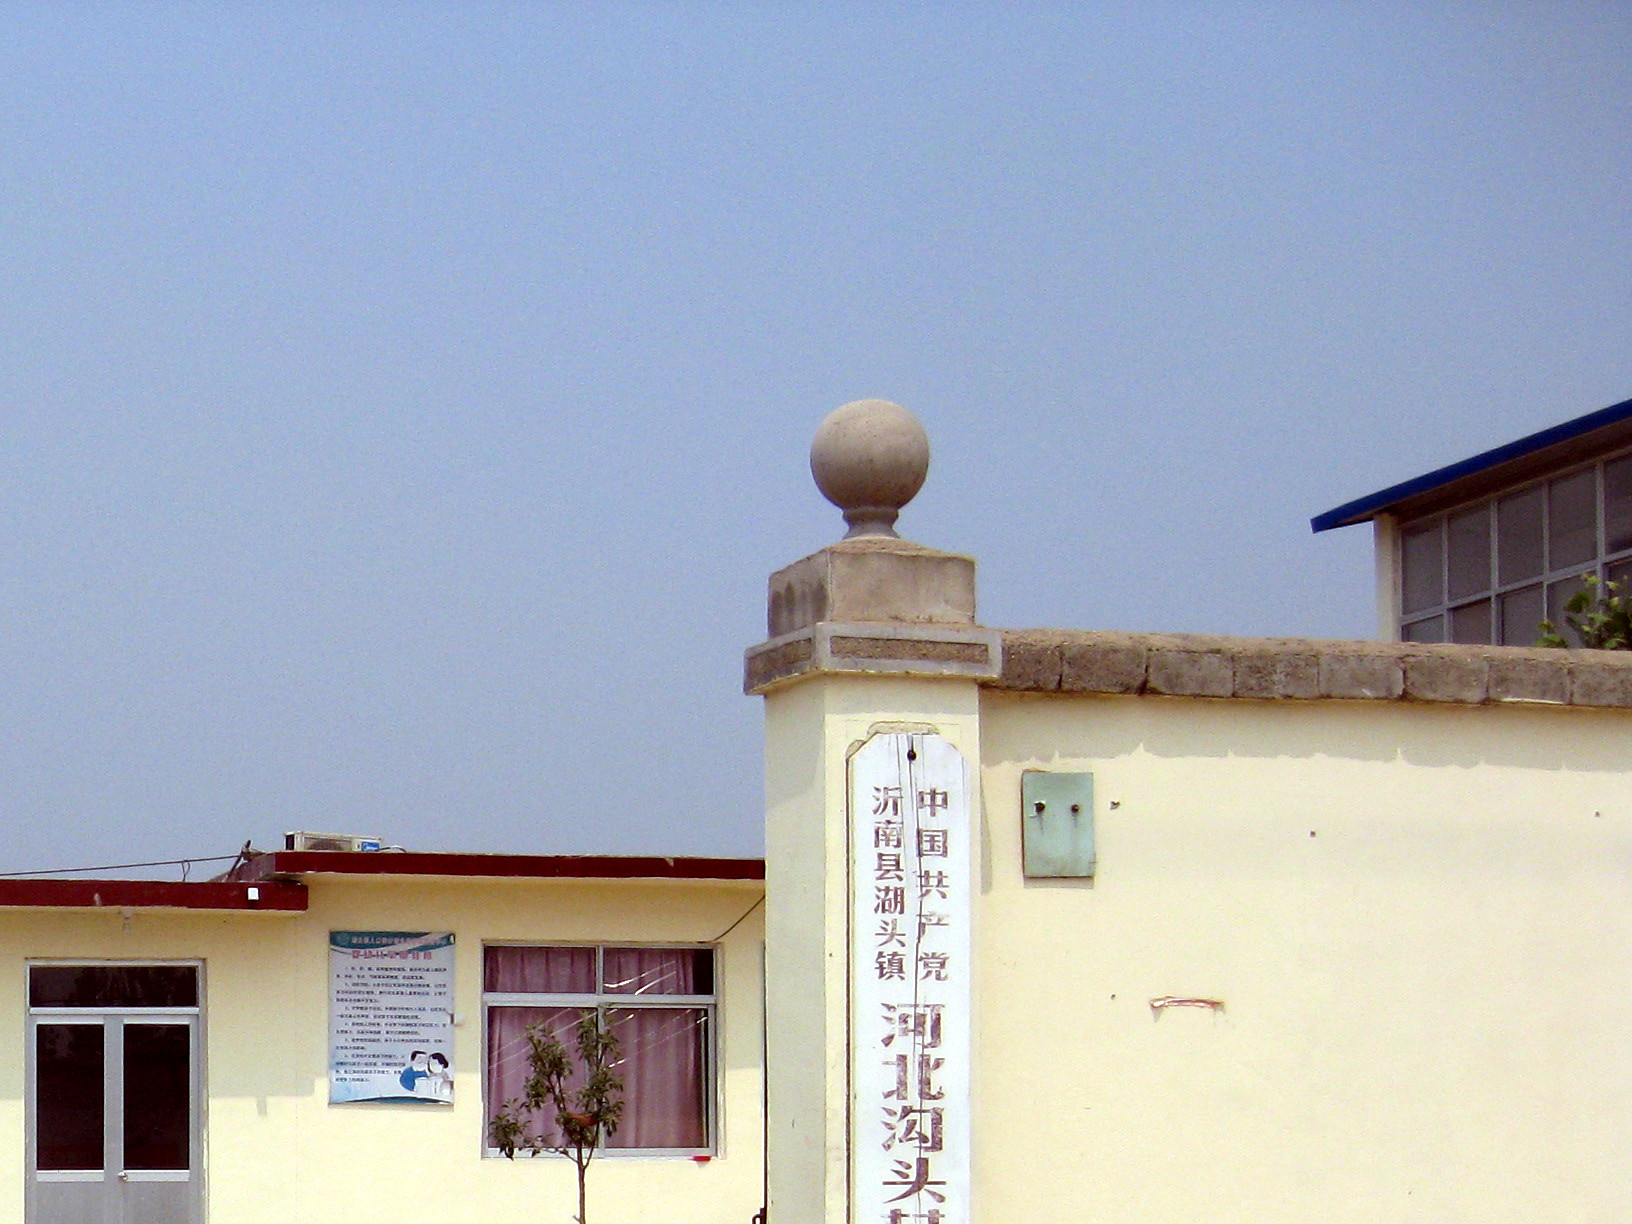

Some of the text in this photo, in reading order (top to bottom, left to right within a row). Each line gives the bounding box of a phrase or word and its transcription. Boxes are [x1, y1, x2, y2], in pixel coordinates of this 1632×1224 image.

[872, 786, 906, 981] 沂南县湖头镇
[917, 787, 950, 982] 中国共产党
